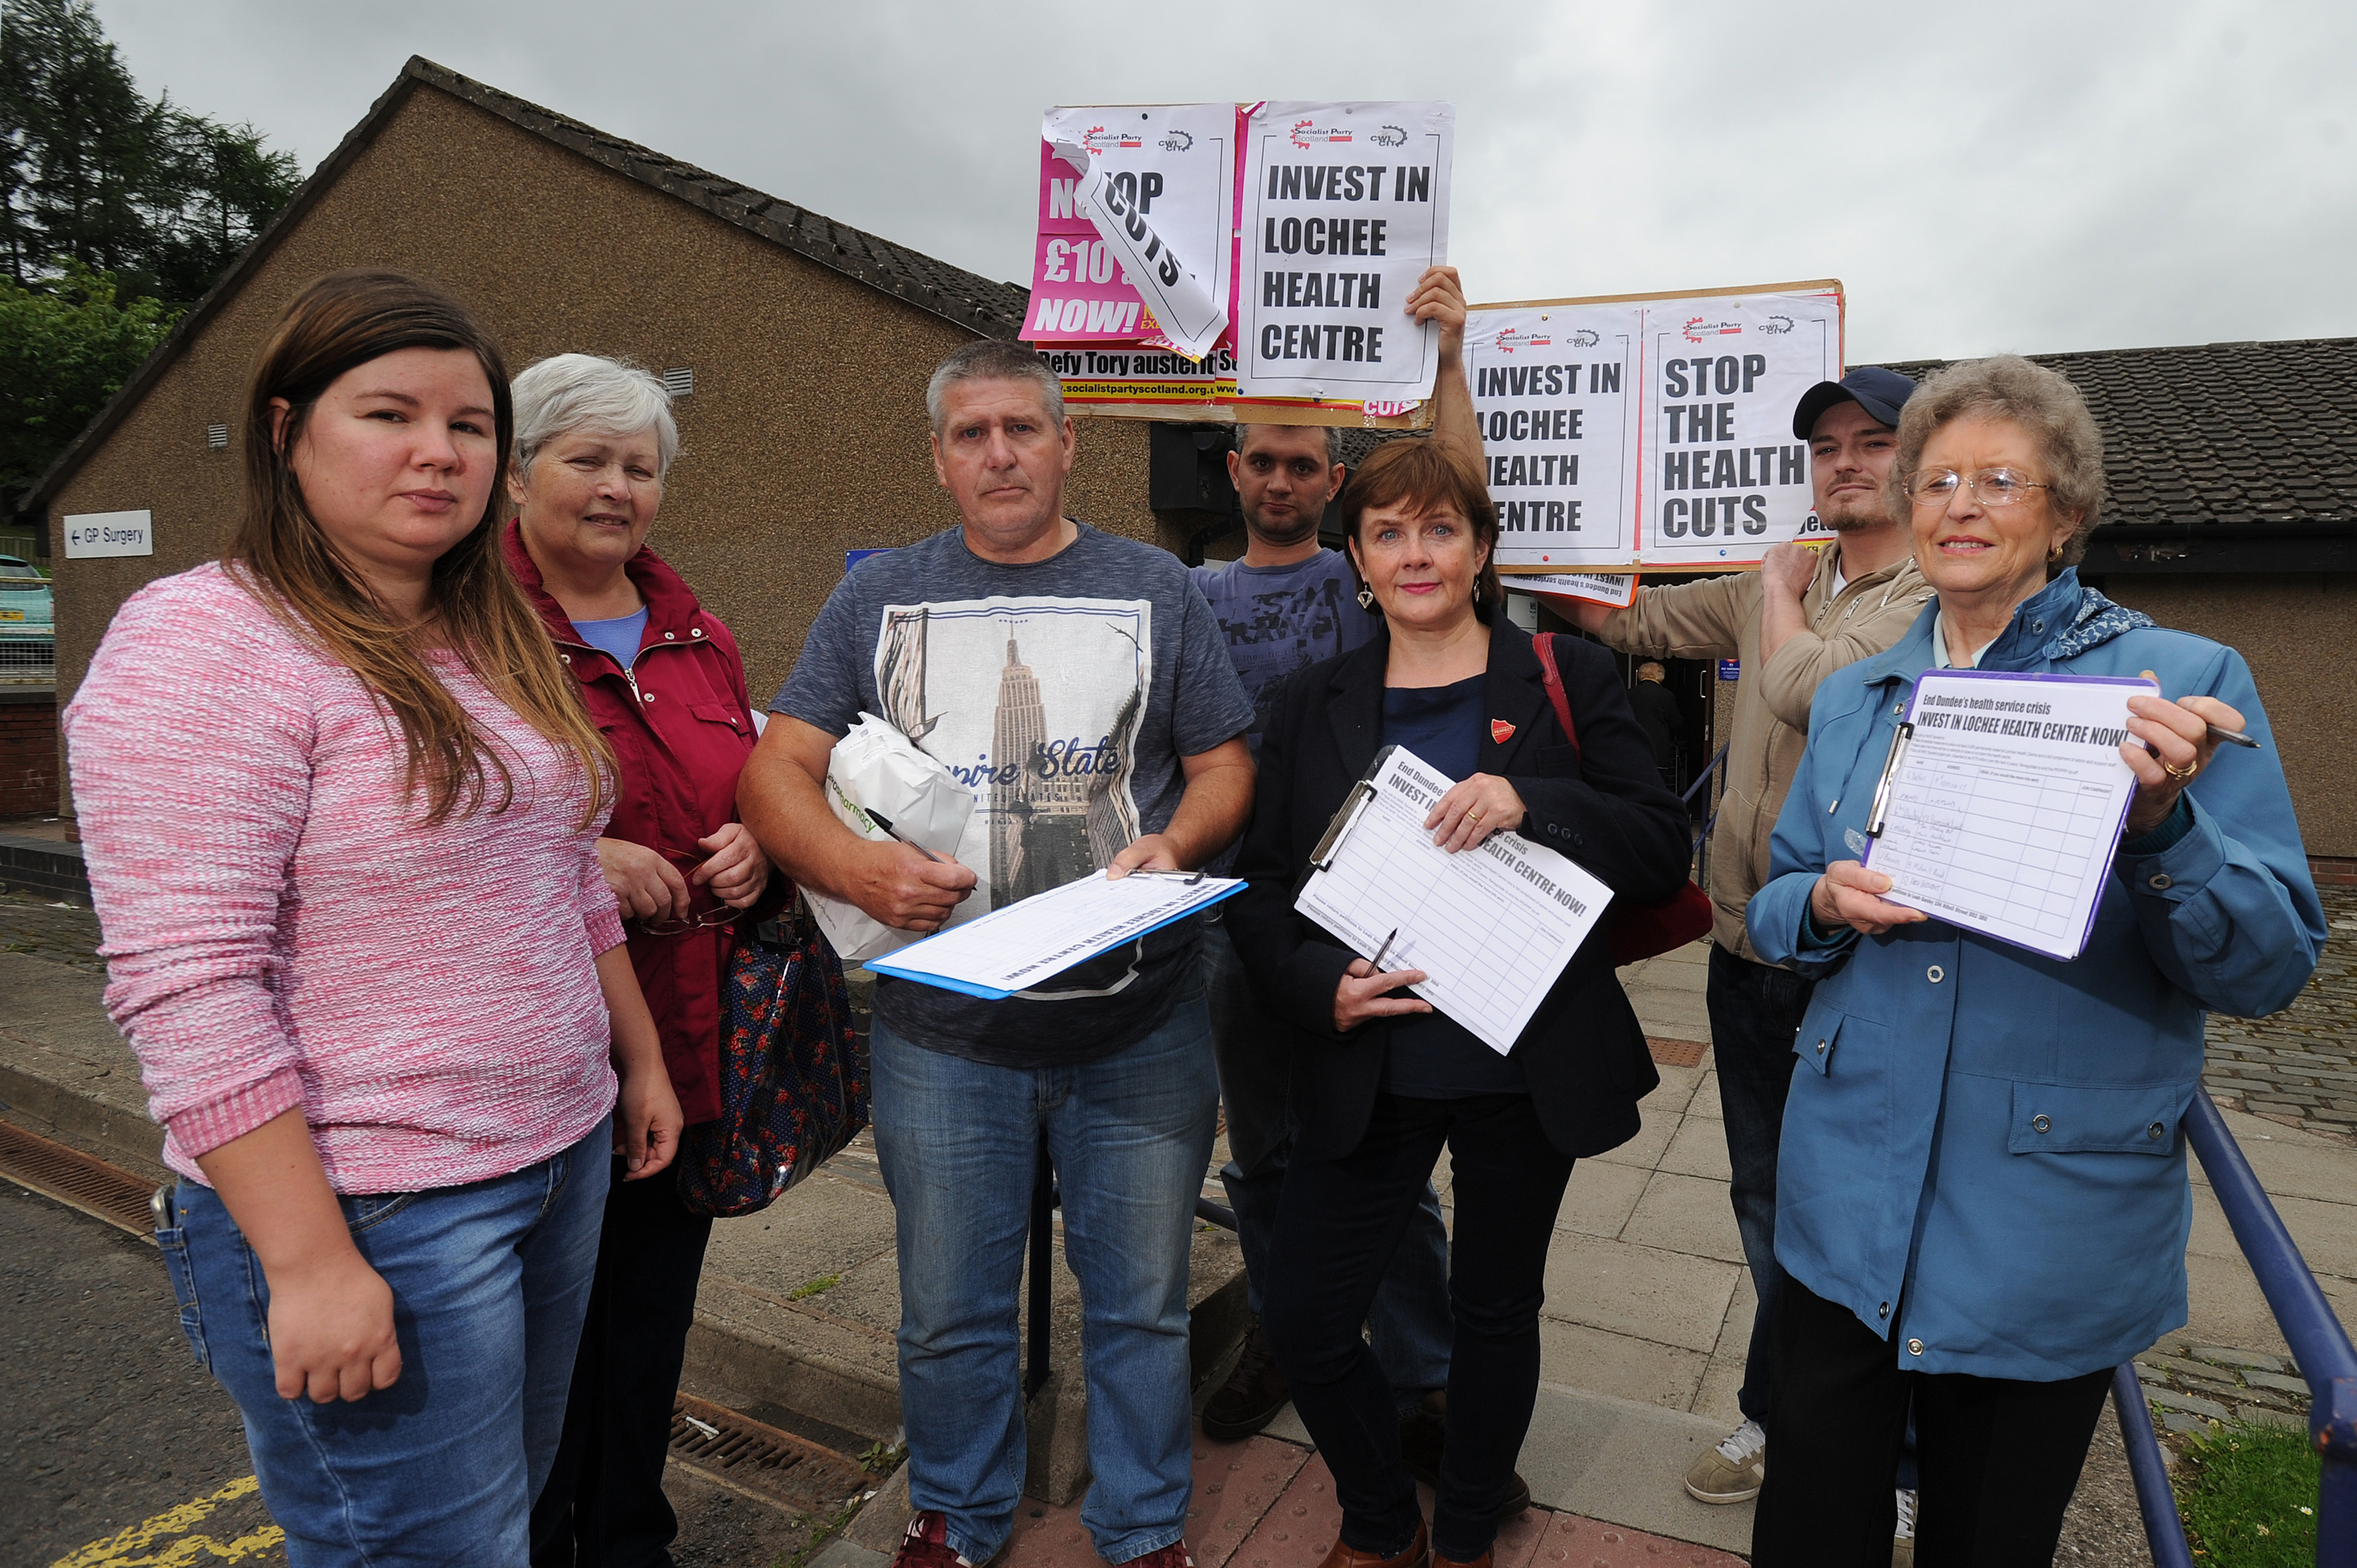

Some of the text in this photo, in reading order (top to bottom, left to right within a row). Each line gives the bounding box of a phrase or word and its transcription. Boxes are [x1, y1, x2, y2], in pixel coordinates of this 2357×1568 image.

[1104, 171, 1163, 214] OP
[1267, 166, 1430, 202] INVEST IN
[1264, 217, 1387, 256] LOCHEE
[1043, 239, 1115, 285] £10
[1263, 271, 1381, 309] HEALTH
[1033, 298, 1140, 333] NOW!
[1261, 324, 1383, 363] CENTRE
[1086, 351, 1129, 376] Tory
[1133, 353, 1215, 375] austerit
[1477, 362, 1621, 397] INVEST IN
[1665, 354, 1766, 398] STOP
[1476, 409, 1583, 441] LOCHEE
[1664, 402, 1735, 444] THE
[1664, 445, 1805, 491] HEALTH
[1493, 501, 1581, 532] ENTRE
[1664, 495, 1767, 539] CUTS
[85, 527, 144, 545] GP Surgery
[1533, 575, 1557, 584] service
[1557, 578, 1579, 588] health
[1579, 581, 1609, 594] Dundee's
[1592, 572, 1624, 587] INVEST
[1609, 588, 1621, 597] End
[1923, 694, 2051, 715] End Dundee's health service crisis
[1917, 711, 1952, 729] INVEST
[1950, 714, 1962, 730] IN
[1963, 715, 1999, 735] LOCHEE
[2000, 719, 2040, 738] HEALTH
[2043, 722, 2088, 743] CENTRE
[945, 735, 1120, 788] pire State
[1386, 772, 1428, 807] INVEST
[1397, 760, 1447, 797] End Dundee'
[973, 793, 1006, 803] NITED
[1503, 833, 1528, 856] crisis
[1512, 859, 1558, 896] CENTRE
[1555, 889, 1587, 918] NOW!
[1123, 904, 1165, 928] LOCHEE
[1083, 923, 1124, 945] HEALTH
[1039, 939, 1086, 965] CENTRE
